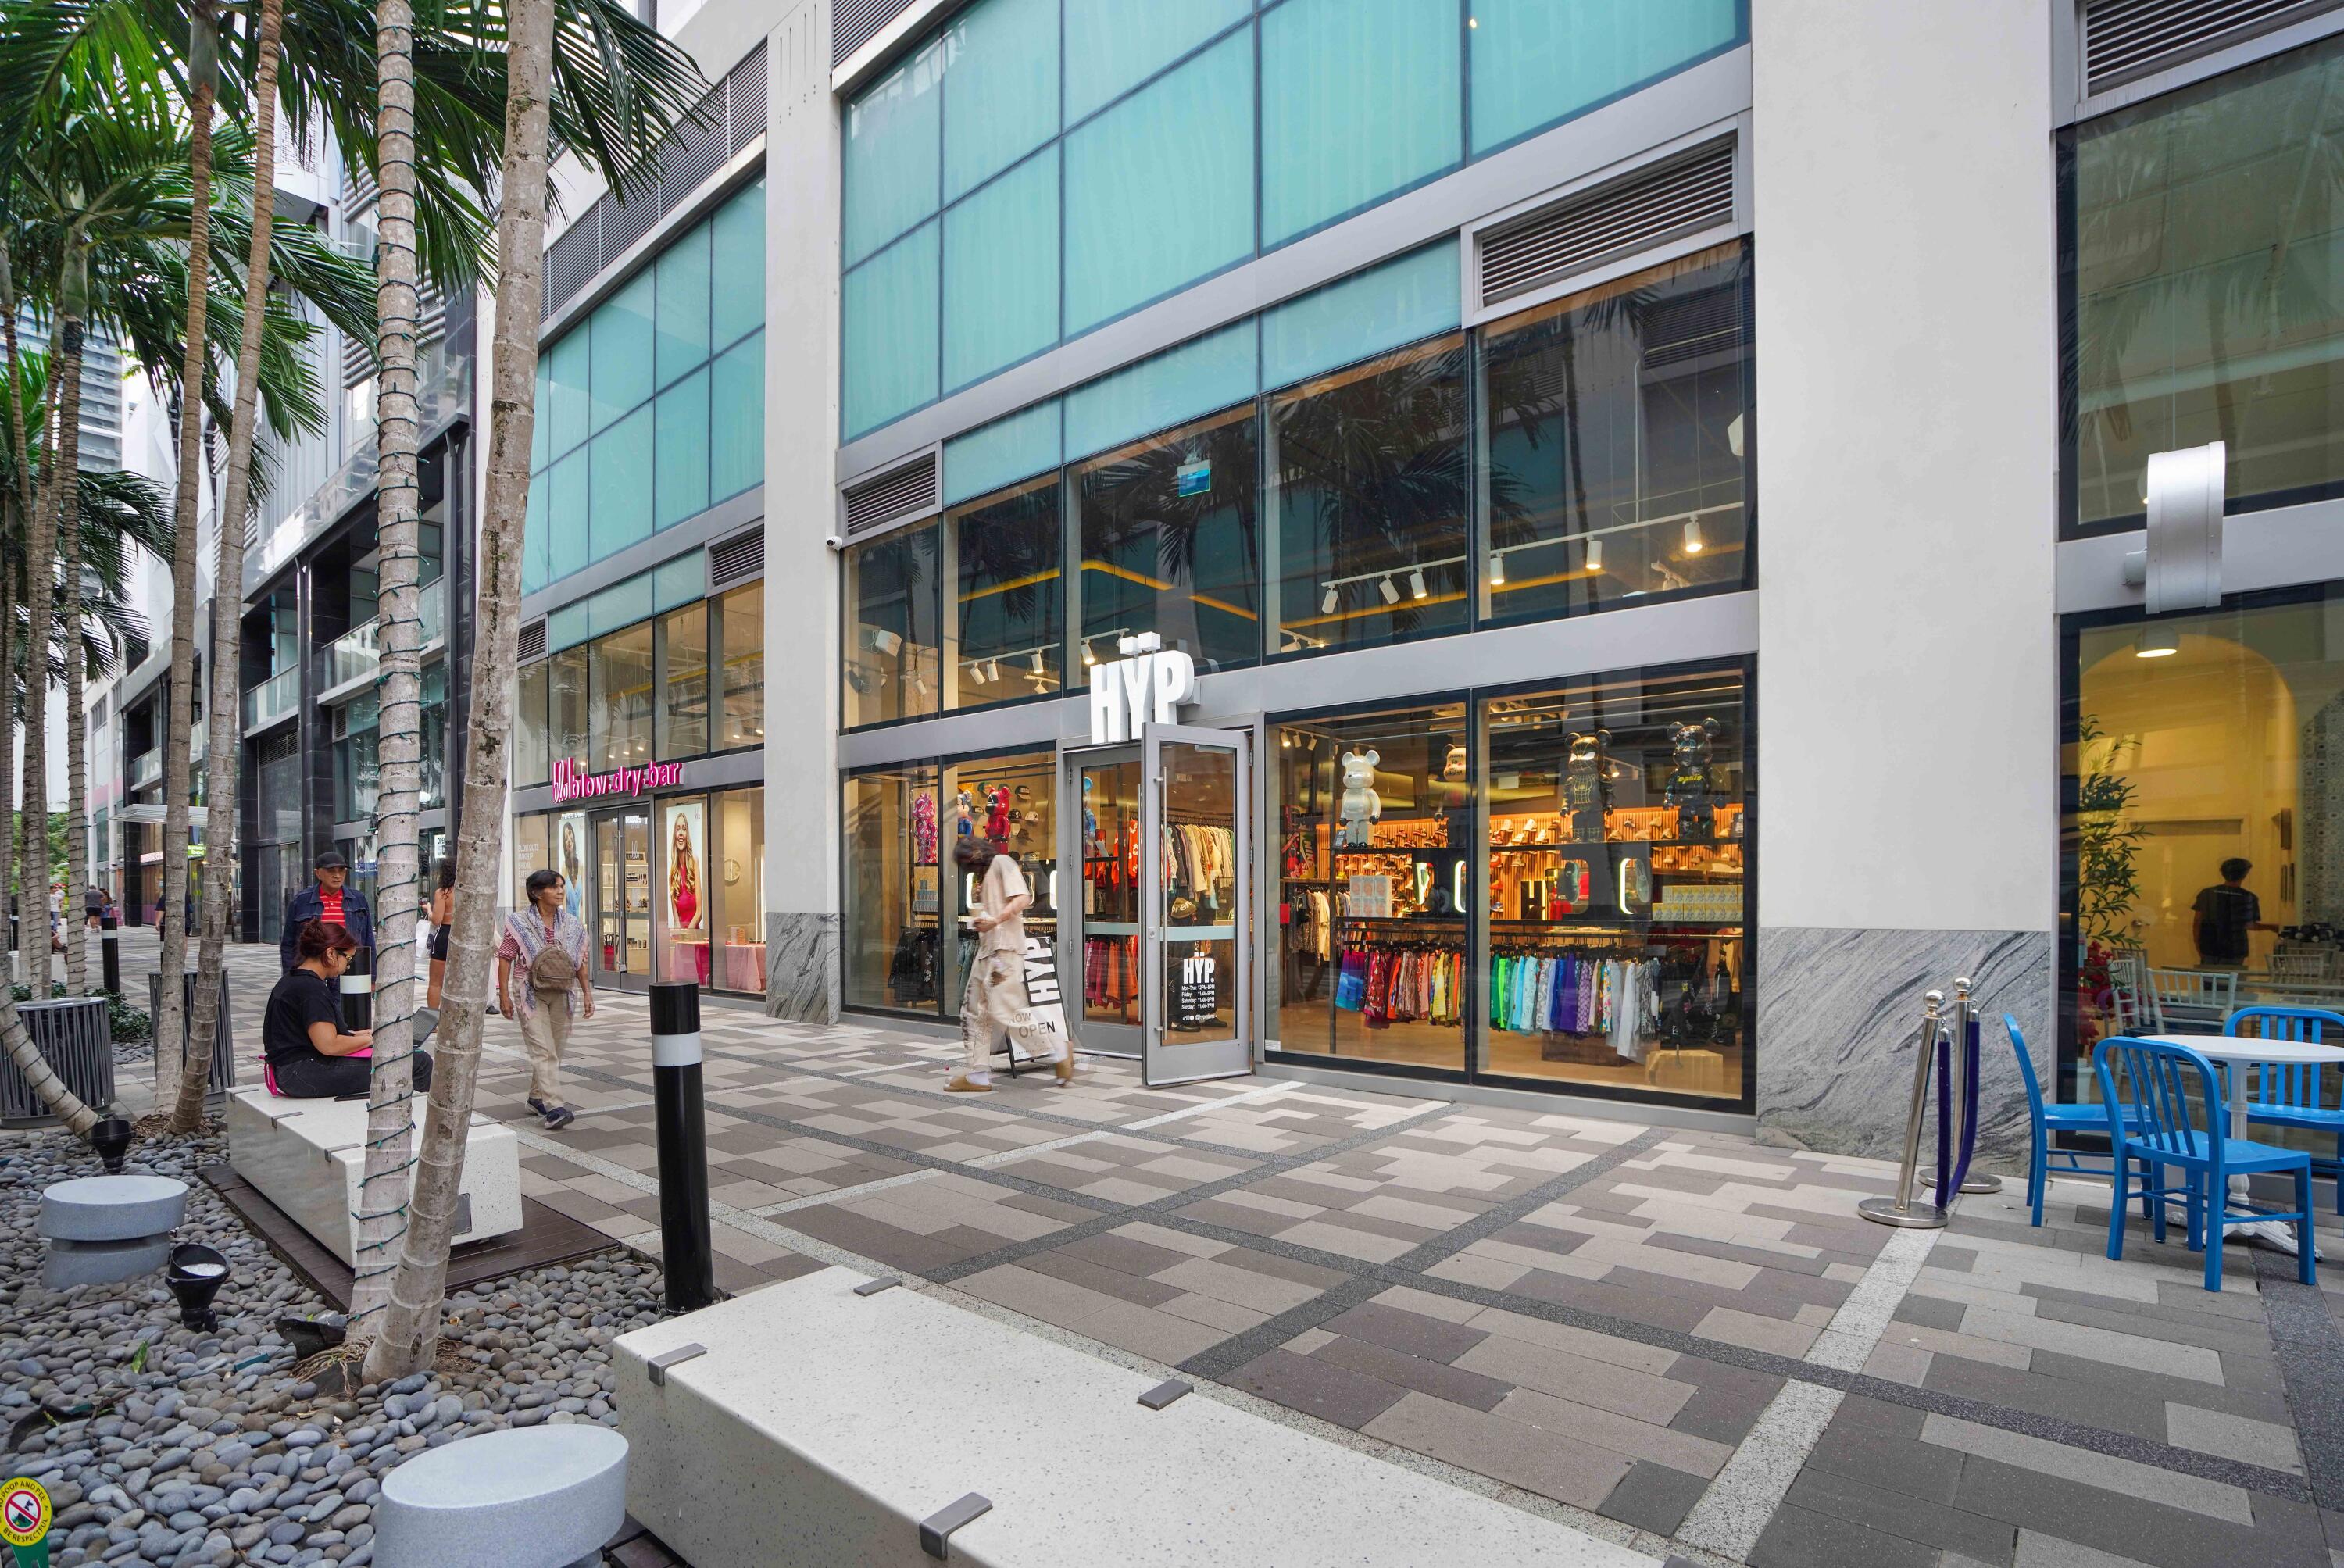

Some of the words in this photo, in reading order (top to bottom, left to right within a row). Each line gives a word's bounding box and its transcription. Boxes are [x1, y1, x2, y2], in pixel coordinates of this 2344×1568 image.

[1019, 1021, 1056, 1038] OPEN
[2, 1481, 19, 1498] POOP
[20, 1480, 35, 1490] AND
[36, 1488, 46, 1502] PEE
[4, 1527, 13, 1538] BE
[13, 1518, 48, 1542] RESPECTFUL
